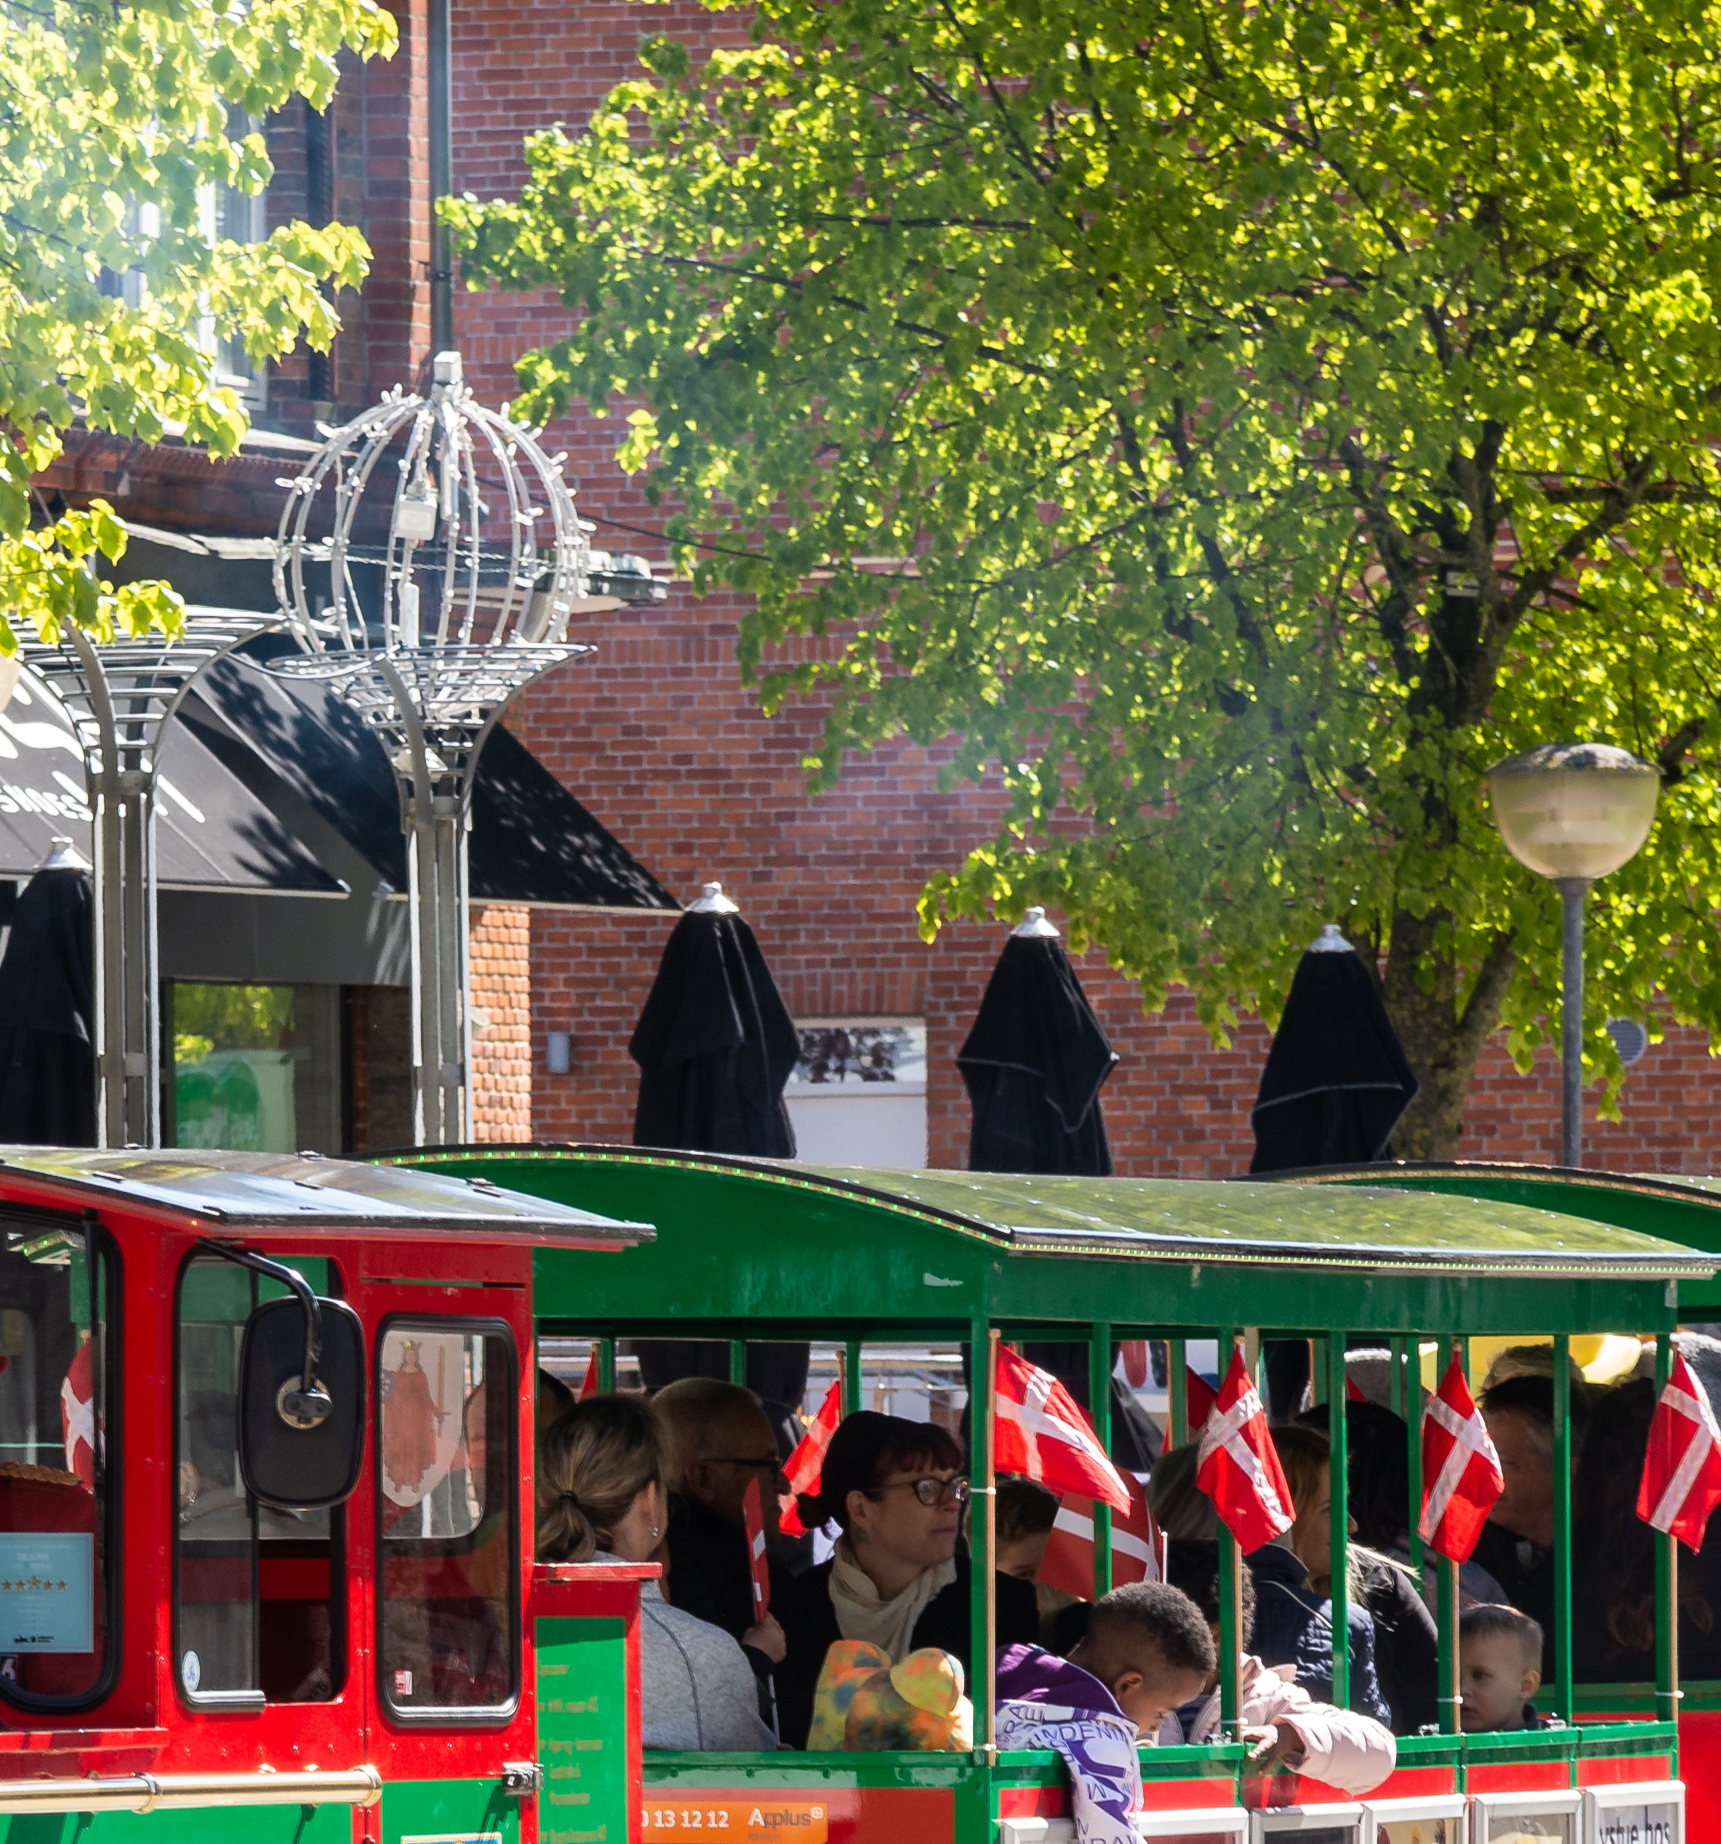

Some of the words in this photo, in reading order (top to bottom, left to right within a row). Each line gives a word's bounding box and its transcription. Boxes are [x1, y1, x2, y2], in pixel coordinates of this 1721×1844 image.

[653, 1810, 675, 1828] 13
[681, 1810, 702, 1828] 12
[707, 1810, 729, 1828] 12
[748, 1807, 811, 1830] Applus
